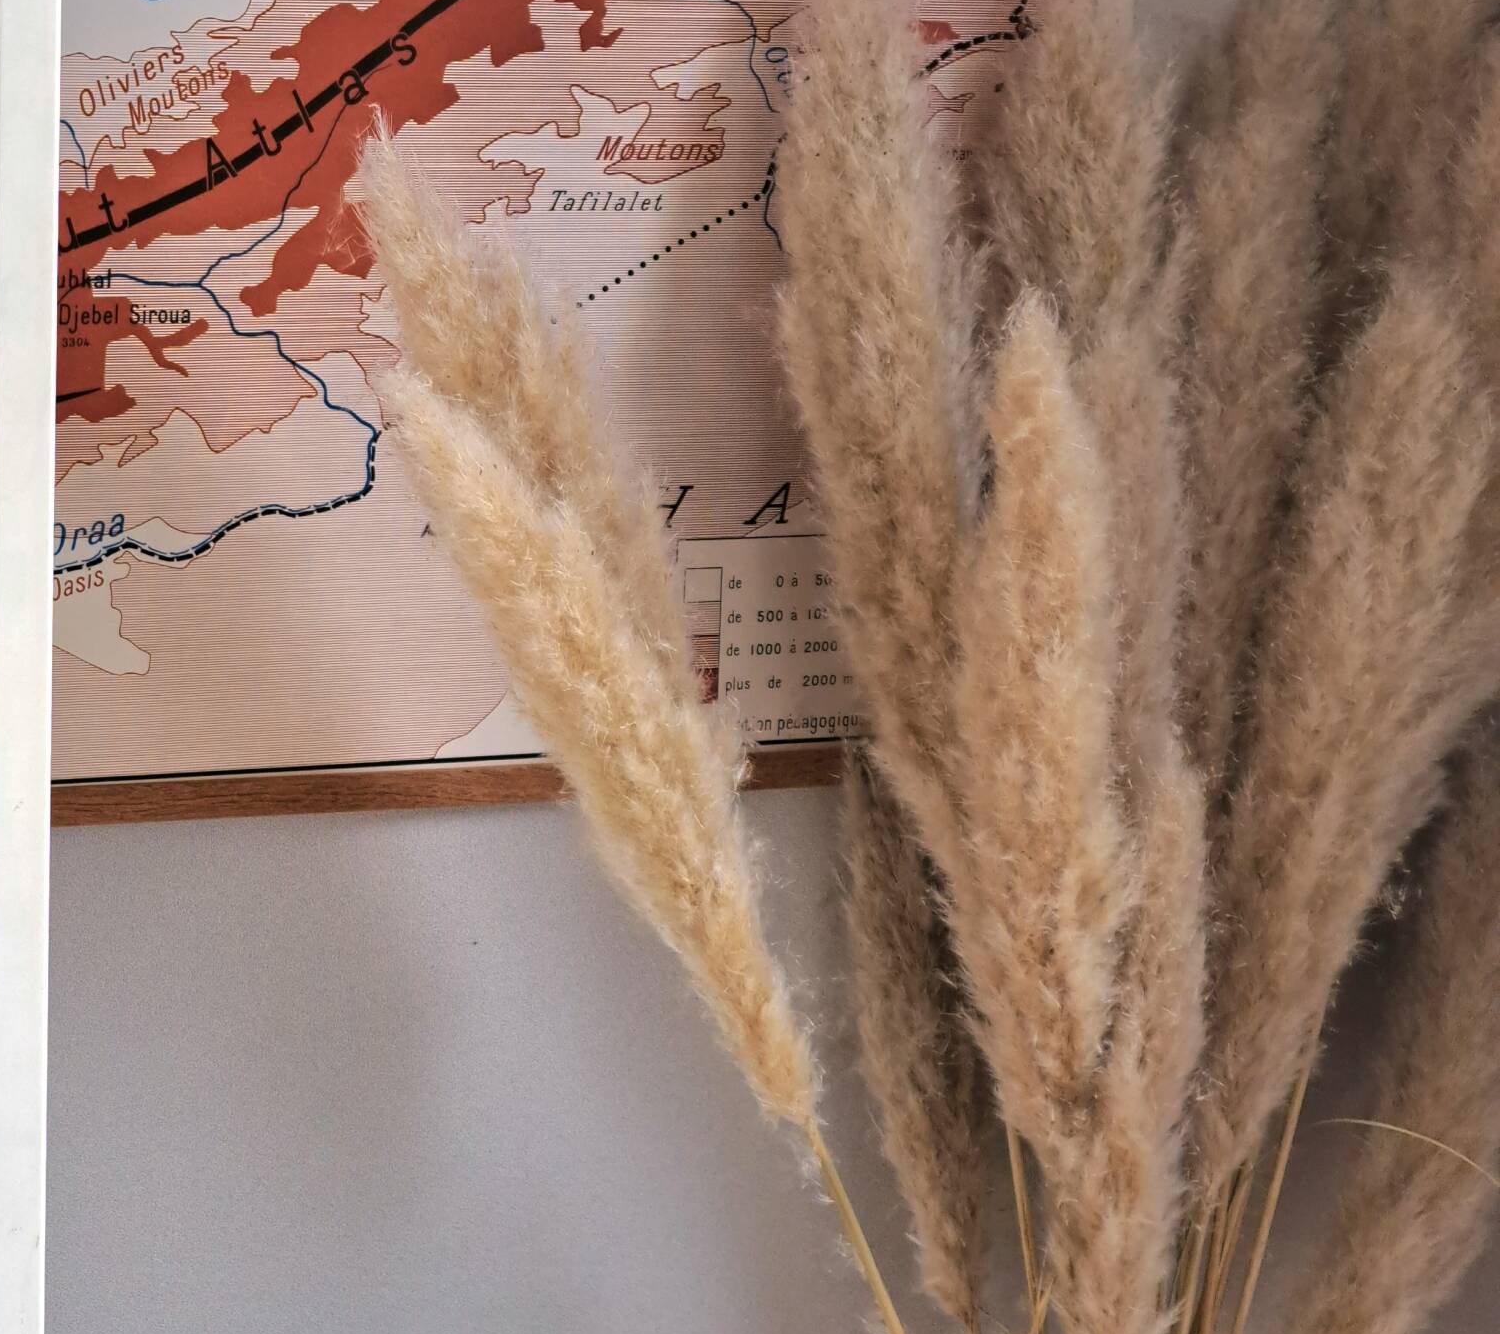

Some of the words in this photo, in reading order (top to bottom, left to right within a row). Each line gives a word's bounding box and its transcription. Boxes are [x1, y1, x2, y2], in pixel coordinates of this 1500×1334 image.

[79, 43, 185, 117] Oliviers
[128, 60, 230, 127] Moutons
[204, 32, 418, 191] Atlas
[596, 134, 723, 163] Moutons
[548, 190, 664, 213] Tafilalet
[59, 303, 119, 334] Djebel
[130, 303, 192, 326] Siroua
[61, 337, 91, 348] 3304
[728, 574, 743, 590] de
[774, 574, 786, 589] 0
[814, 573, 833, 587] 50
[726, 608, 742, 625] de
[756, 609, 784, 623] 500
[725, 641, 741, 657] de
[750, 641, 783, 656] 1000
[803, 640, 839, 654] 2000
[725, 677, 751, 694] plus
[766, 674, 783, 689] de
[802, 674, 837, 687] 2000
